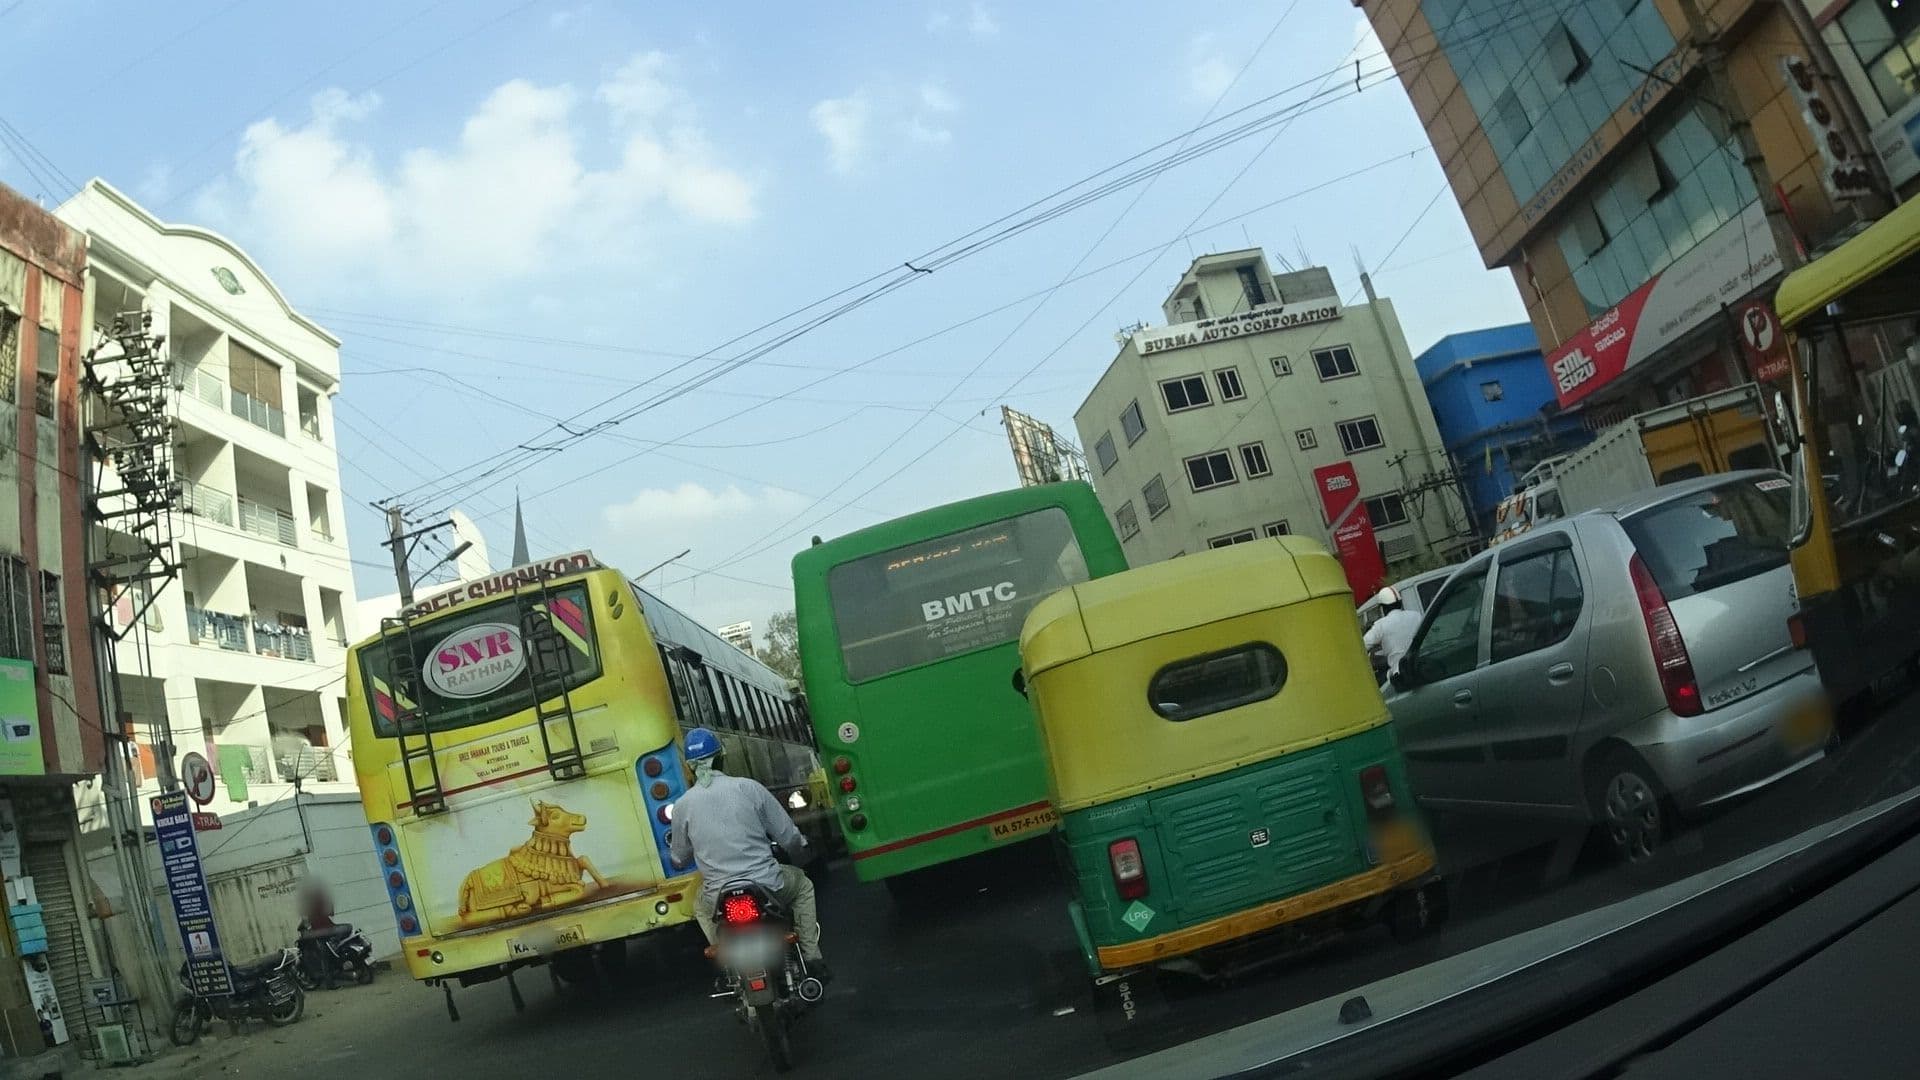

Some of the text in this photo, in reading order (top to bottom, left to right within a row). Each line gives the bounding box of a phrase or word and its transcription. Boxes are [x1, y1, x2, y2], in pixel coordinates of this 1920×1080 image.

[1144, 331, 1197, 353] BURMA
[1202, 323, 1240, 342] AUTO
[1243, 305, 1338, 333] CORPORATION
[1553, 348, 1592, 380] SML
[1559, 360, 1597, 394] ISUZU
[921, 581, 1017, 622] BMTC
[437, 631, 514, 675] SNR
[446, 658, 515, 688] RATHNA
[491, 743, 506, 754] TOURS
[510, 735, 530, 749] TRAVELS
[994, 823, 1009, 837] KA
[1128, 910, 1149, 922] LPG
[195, 933, 203, 945] 1
[513, 930, 579, 954] KA 064
[1119, 981, 1137, 1021] STOP
